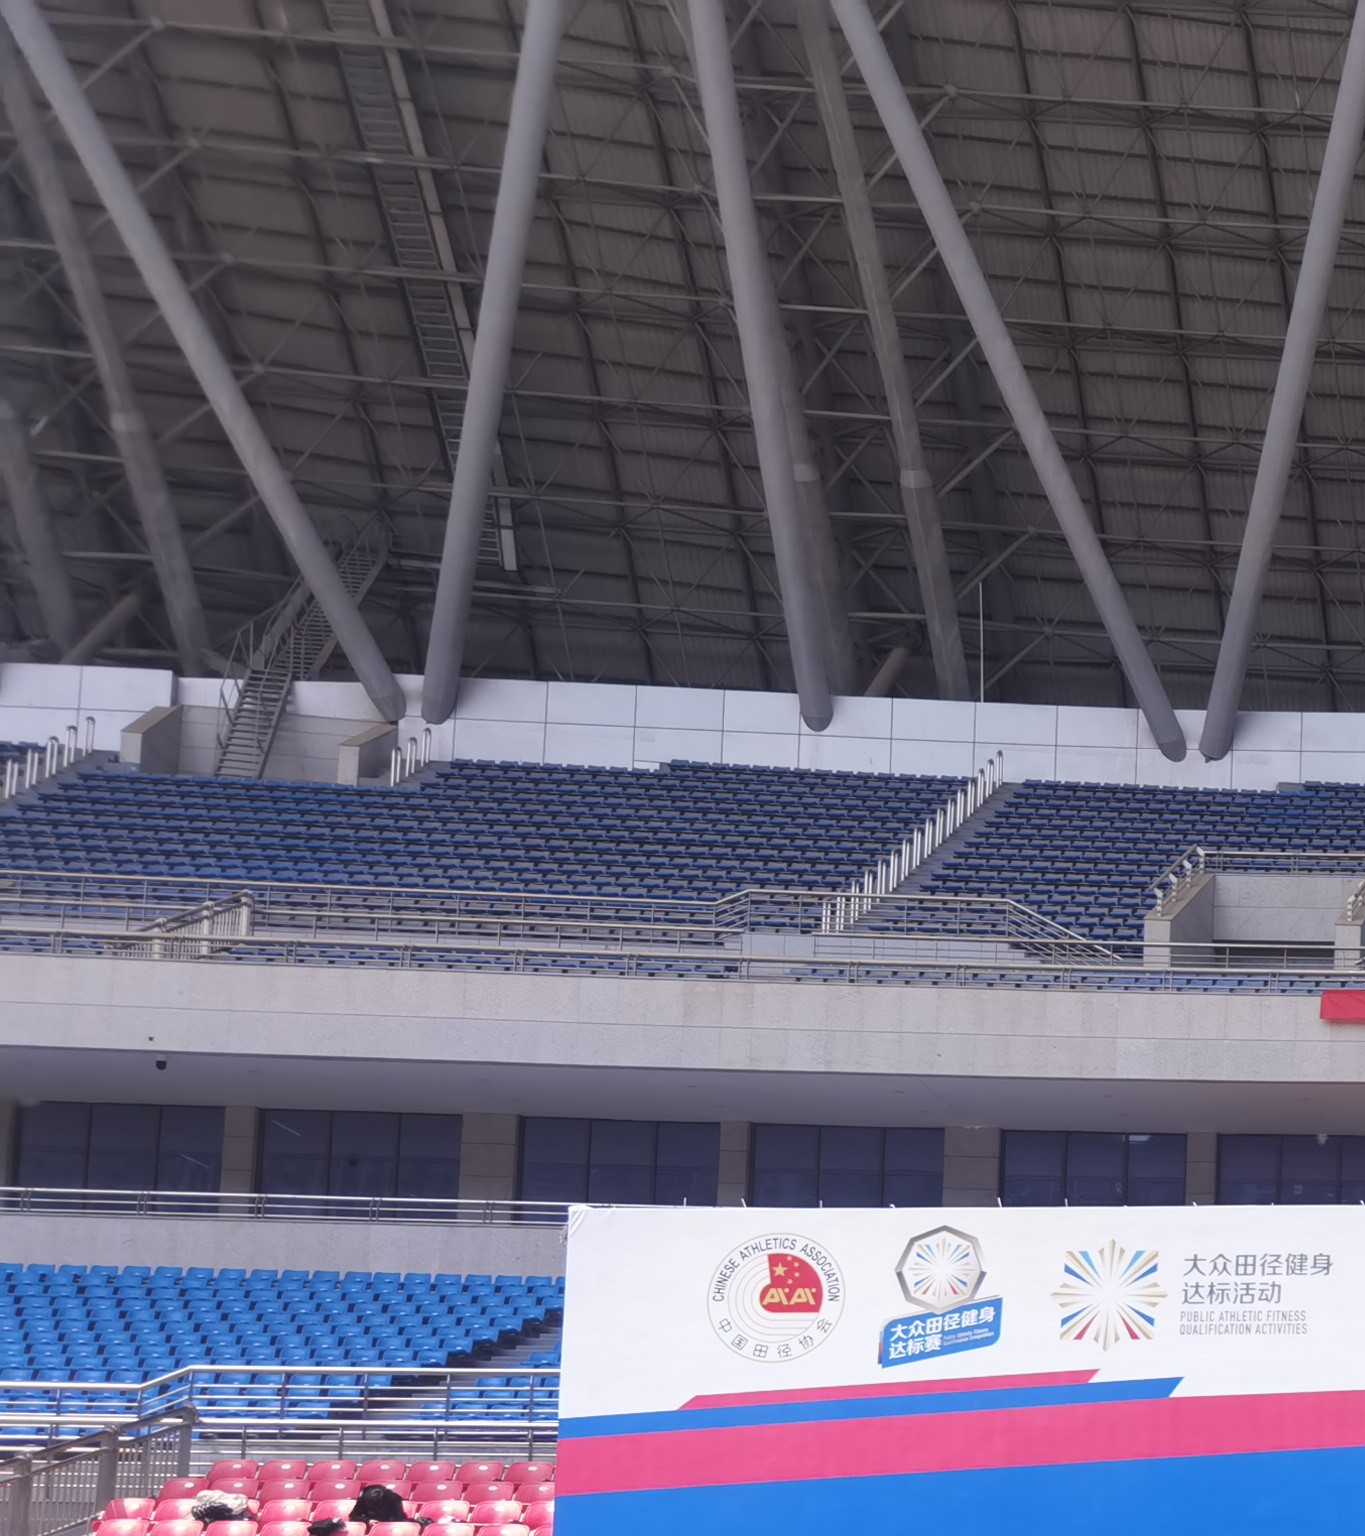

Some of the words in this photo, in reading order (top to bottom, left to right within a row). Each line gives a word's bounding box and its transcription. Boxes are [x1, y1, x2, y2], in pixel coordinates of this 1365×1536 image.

[711, 1257, 741, 1303] CHINESE
[738, 1236, 797, 1262] ATHLETICS
[799, 1242, 840, 1303] ASSOCIATION
[1182, 1252, 1334, 1277] 大众田径健身
[1181, 1281, 1282, 1305] 达标活动
[890, 1305, 997, 1342] 大众田径健身
[1179, 1323, 1252, 1335] QUALIFICATION
[1255, 1323, 1308, 1335] ACTIVITIES
[1180, 1310, 1214, 1322] PUBLIC
[1218, 1310, 1263, 1322] ATHLETIC
[1266, 1310, 1306, 1322] FITNESS
[719, 1317, 833, 1359] 中国田径协会
[888, 1333, 943, 1360] 达标赛
